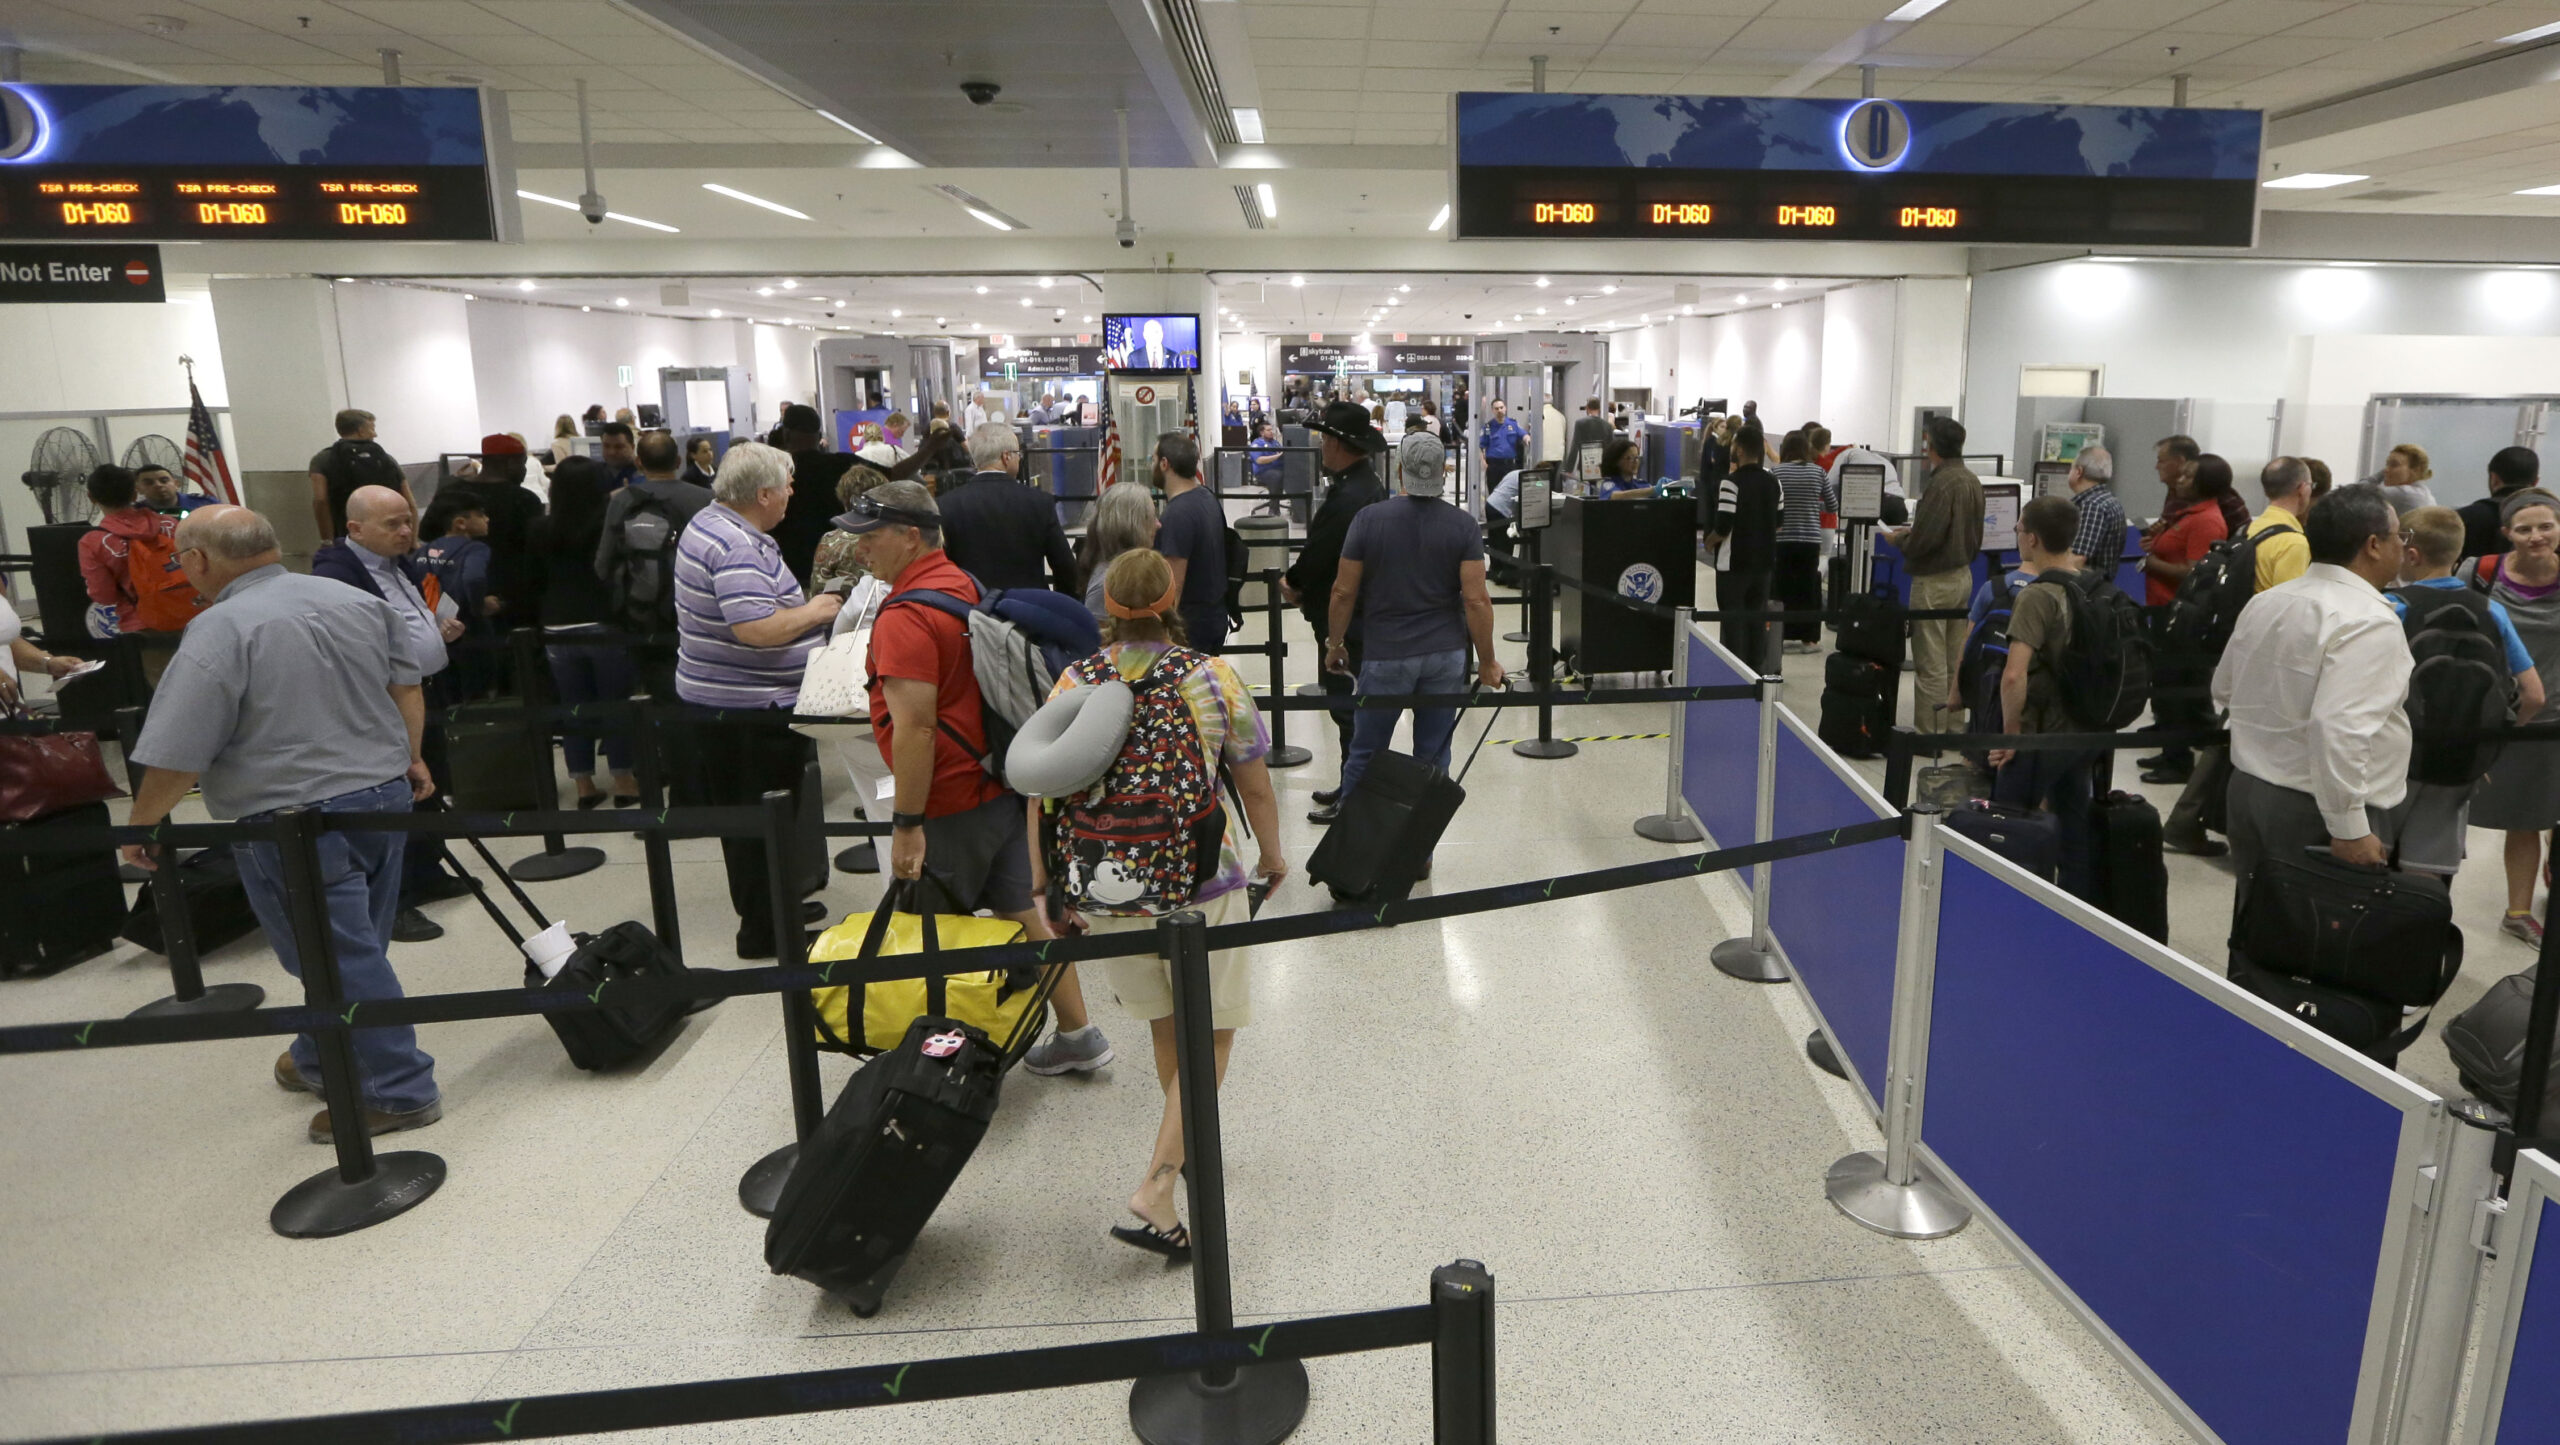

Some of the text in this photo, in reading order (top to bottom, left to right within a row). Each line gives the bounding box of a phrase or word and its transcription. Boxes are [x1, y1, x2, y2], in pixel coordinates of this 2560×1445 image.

[40, 184, 139, 193] TSA PRE-CHECK
[178, 184, 276, 193] TSA PRE-CHECK
[321, 184, 418, 192] TSA PRE-CHECK
[63, 203, 130, 224] D1-D60
[199, 203, 266, 224] D1-D60
[340, 203, 407, 224] D1-D60
[1535, 203, 1593, 223] D1-D60
[1653, 204, 1710, 224] D1-D60
[1779, 206, 1835, 226] D1-D60
[1901, 207, 1956, 227] D1-D60
[0, 262, 112, 282] Not Enter
